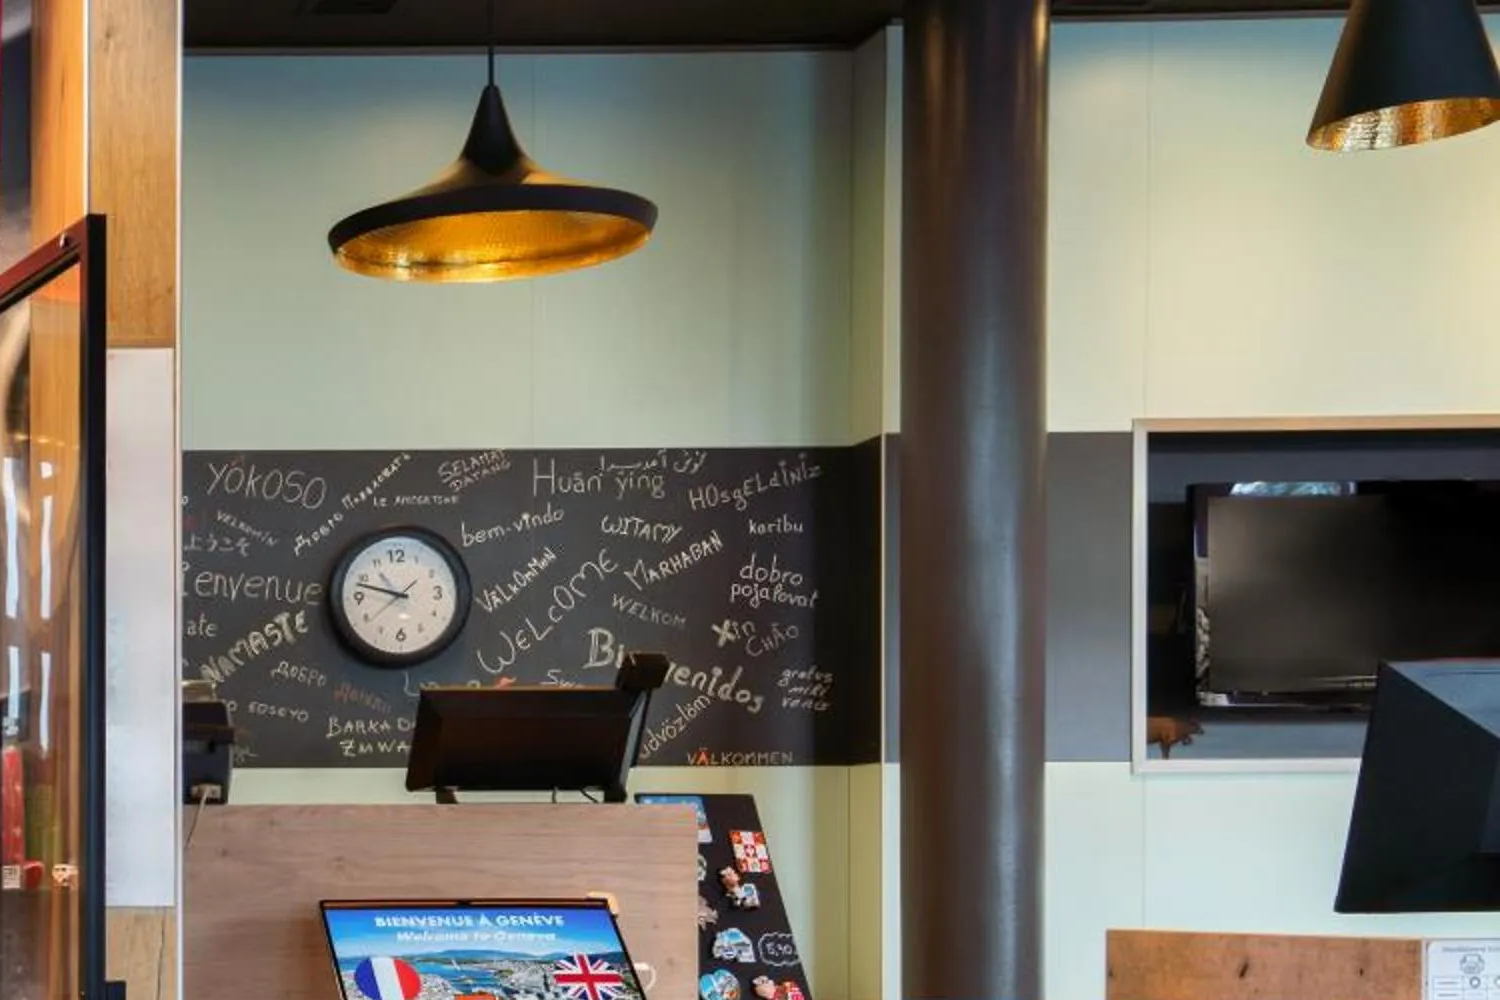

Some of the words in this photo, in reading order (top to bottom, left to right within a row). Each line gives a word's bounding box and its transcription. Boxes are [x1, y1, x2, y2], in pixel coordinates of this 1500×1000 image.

[460, 500, 565, 548] bem-vindo
[748, 513, 804, 536] karibu
[386, 550, 405, 563] 12
[738, 552, 804, 586] dobro
[352, 590, 365, 606] 9
[432, 585, 443, 601] 3
[611, 594, 687, 628] WELKOM
[395, 627, 407, 642] 6
[199, 608, 310, 684] NAMASTE
[374, 914, 474, 928] BIENVENUE
[479, 913, 494, 928] À
[496, 911, 566, 928] GENÈVE
[396, 929, 470, 943] Welcome
[492, 929, 558, 943] Geneva
